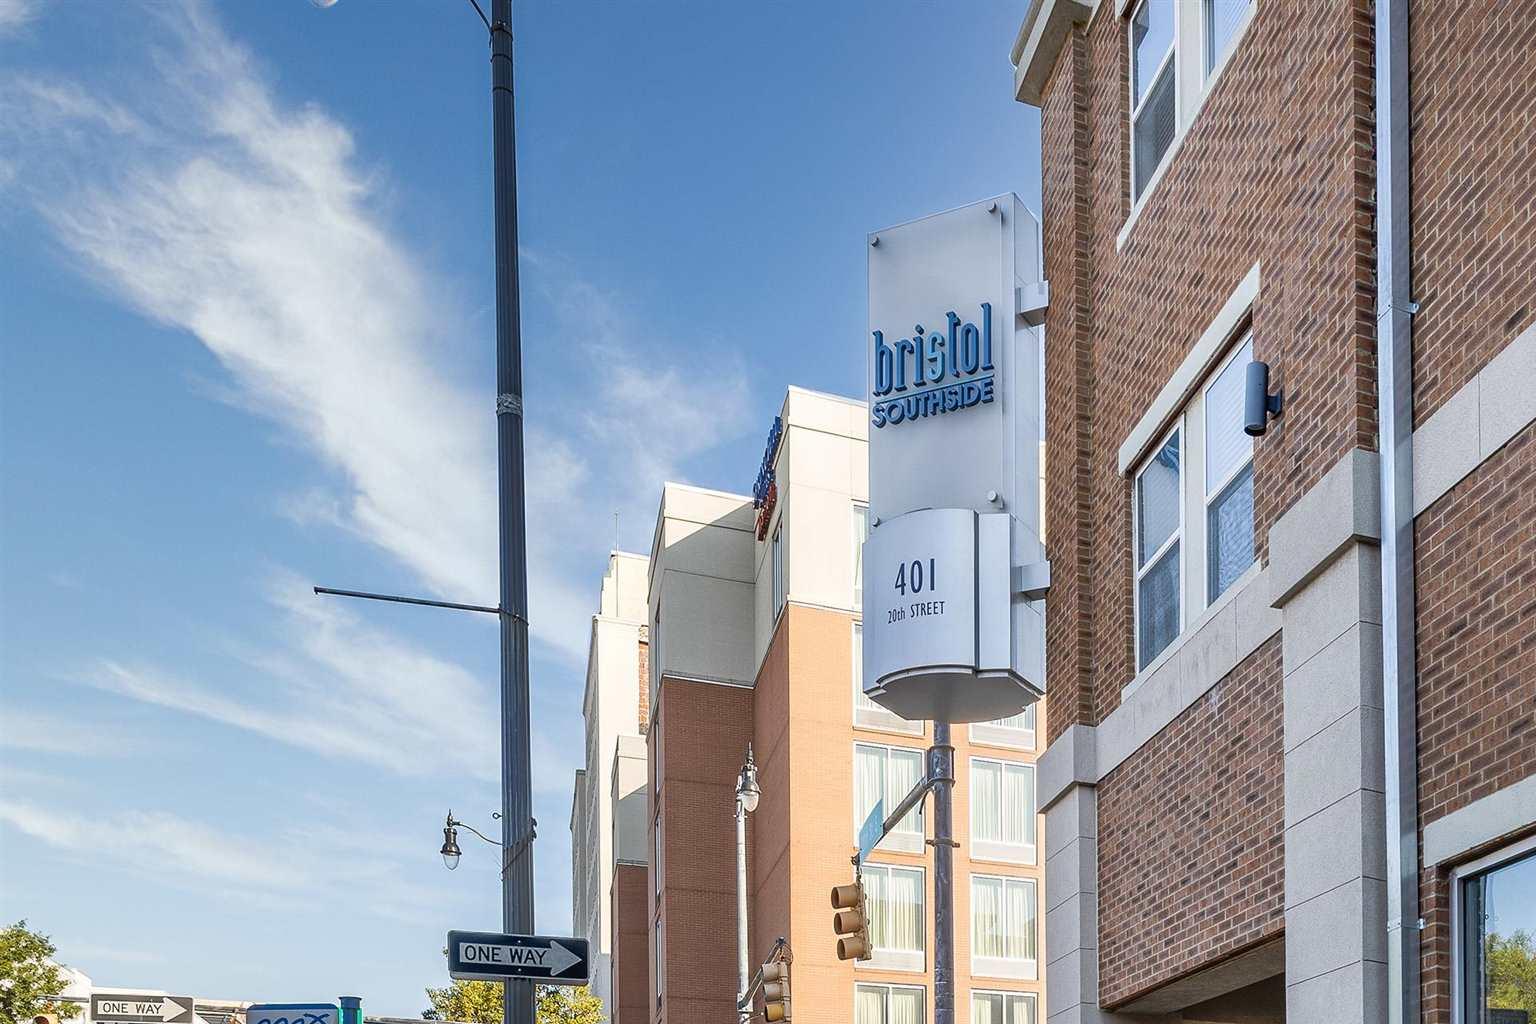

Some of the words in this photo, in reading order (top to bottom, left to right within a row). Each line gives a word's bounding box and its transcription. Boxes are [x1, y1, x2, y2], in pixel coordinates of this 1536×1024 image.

[872, 302, 994, 397] bristol
[872, 379, 994, 428] SOUTHSIDE
[895, 558, 935, 596] 401
[888, 607, 906, 624] 20th
[910, 601, 945, 618] STREET
[464, 945, 502, 962] ONE
[509, 947, 547, 965] WAY
[103, 1002, 129, 1013] ONE
[135, 1003, 161, 1014] WAY
